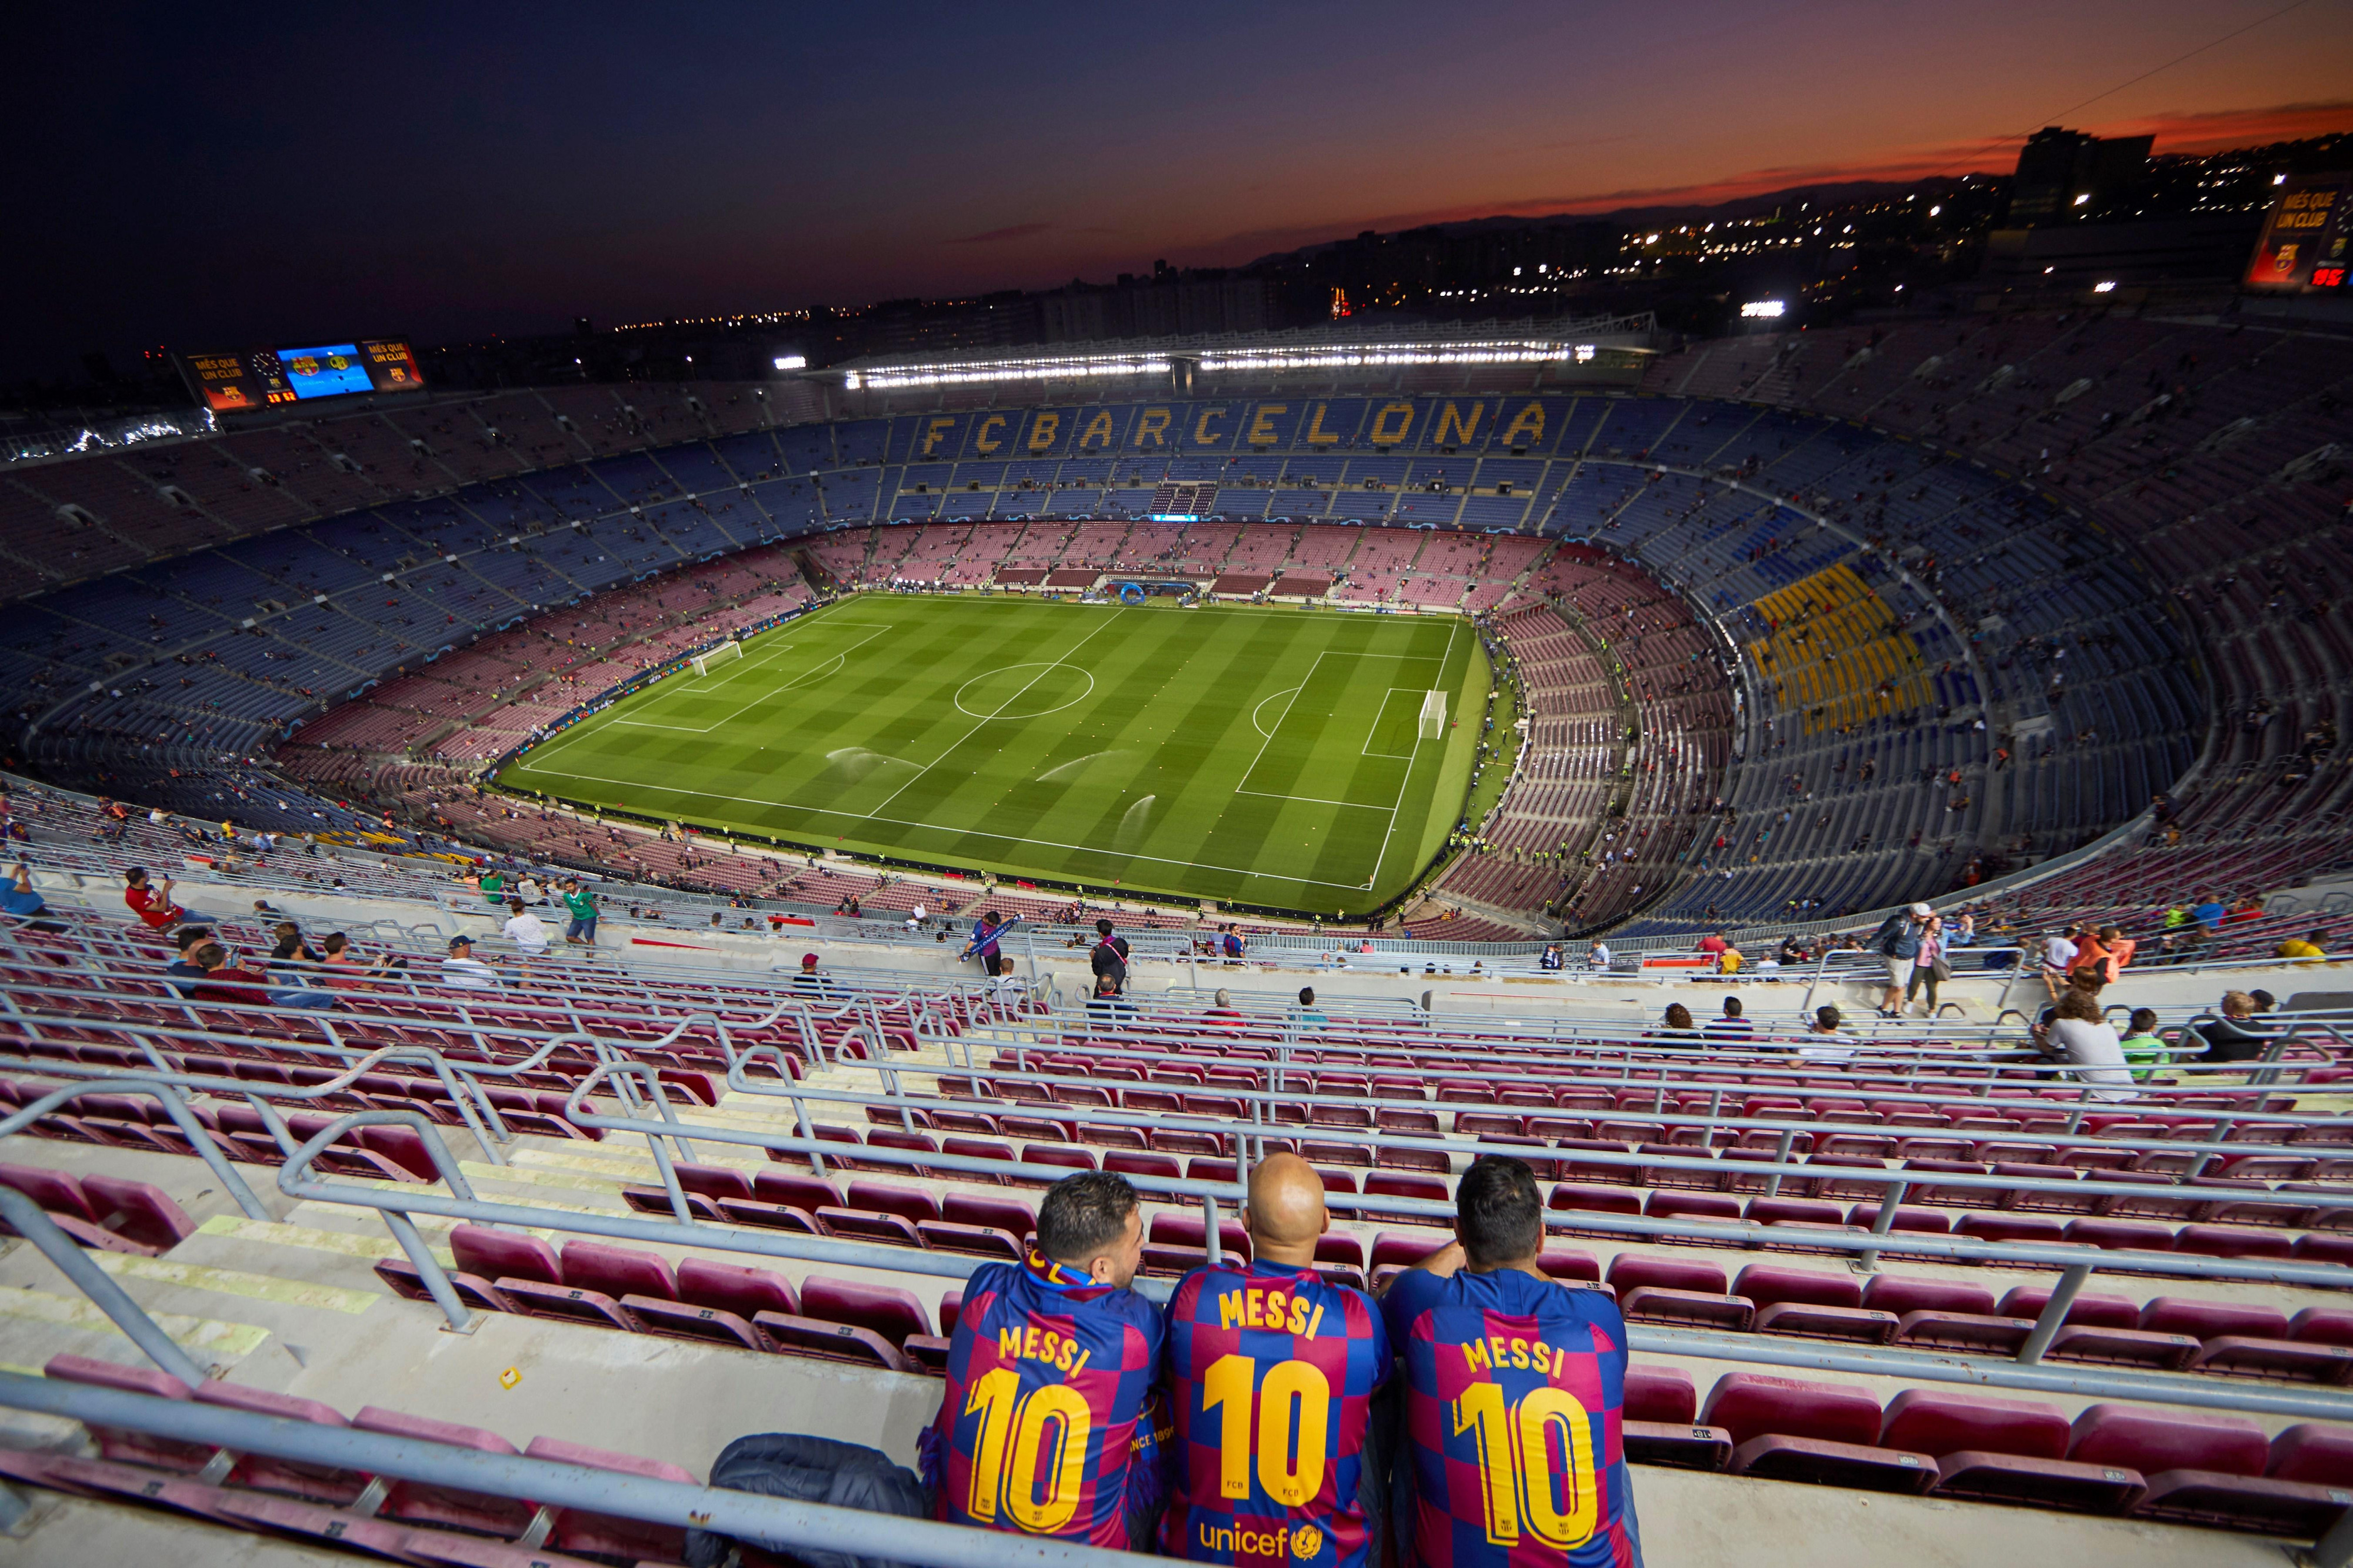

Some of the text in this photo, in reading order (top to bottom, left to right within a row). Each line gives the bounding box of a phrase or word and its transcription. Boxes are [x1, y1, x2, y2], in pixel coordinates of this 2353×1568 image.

[2282, 189, 2338, 211] MÉS QUE
[2276, 211, 2328, 228] UN CLUB
[369, 343, 405, 353] MÉS QUE
[386, 352, 408, 362] CLUB
[195, 358, 239, 371] MÉS QUE
[201, 369, 243, 380] UN CLUB
[923, 400, 1546, 454] FC BARCELONA
[649, 659, 692, 685] UEFA FOUNDATIO
[543, 729, 557, 741] UEFA
[556, 708, 594, 733] FOUNDATION
[972, 928, 1005, 953] MILLONARIOS
[1218, 1289, 1324, 1341] MESSI
[999, 1326, 1091, 1379] MESSI
[1461, 1337, 1565, 1379] MESSI
[1202, 1354, 1330, 1507] 10
[965, 1367, 1091, 1534] 10
[1452, 1382, 1598, 1550] 10
[1227, 1480, 1244, 1490] FCB
[1282, 1487, 1299, 1497] FCB
[1199, 1522, 1288, 1558] unicef
